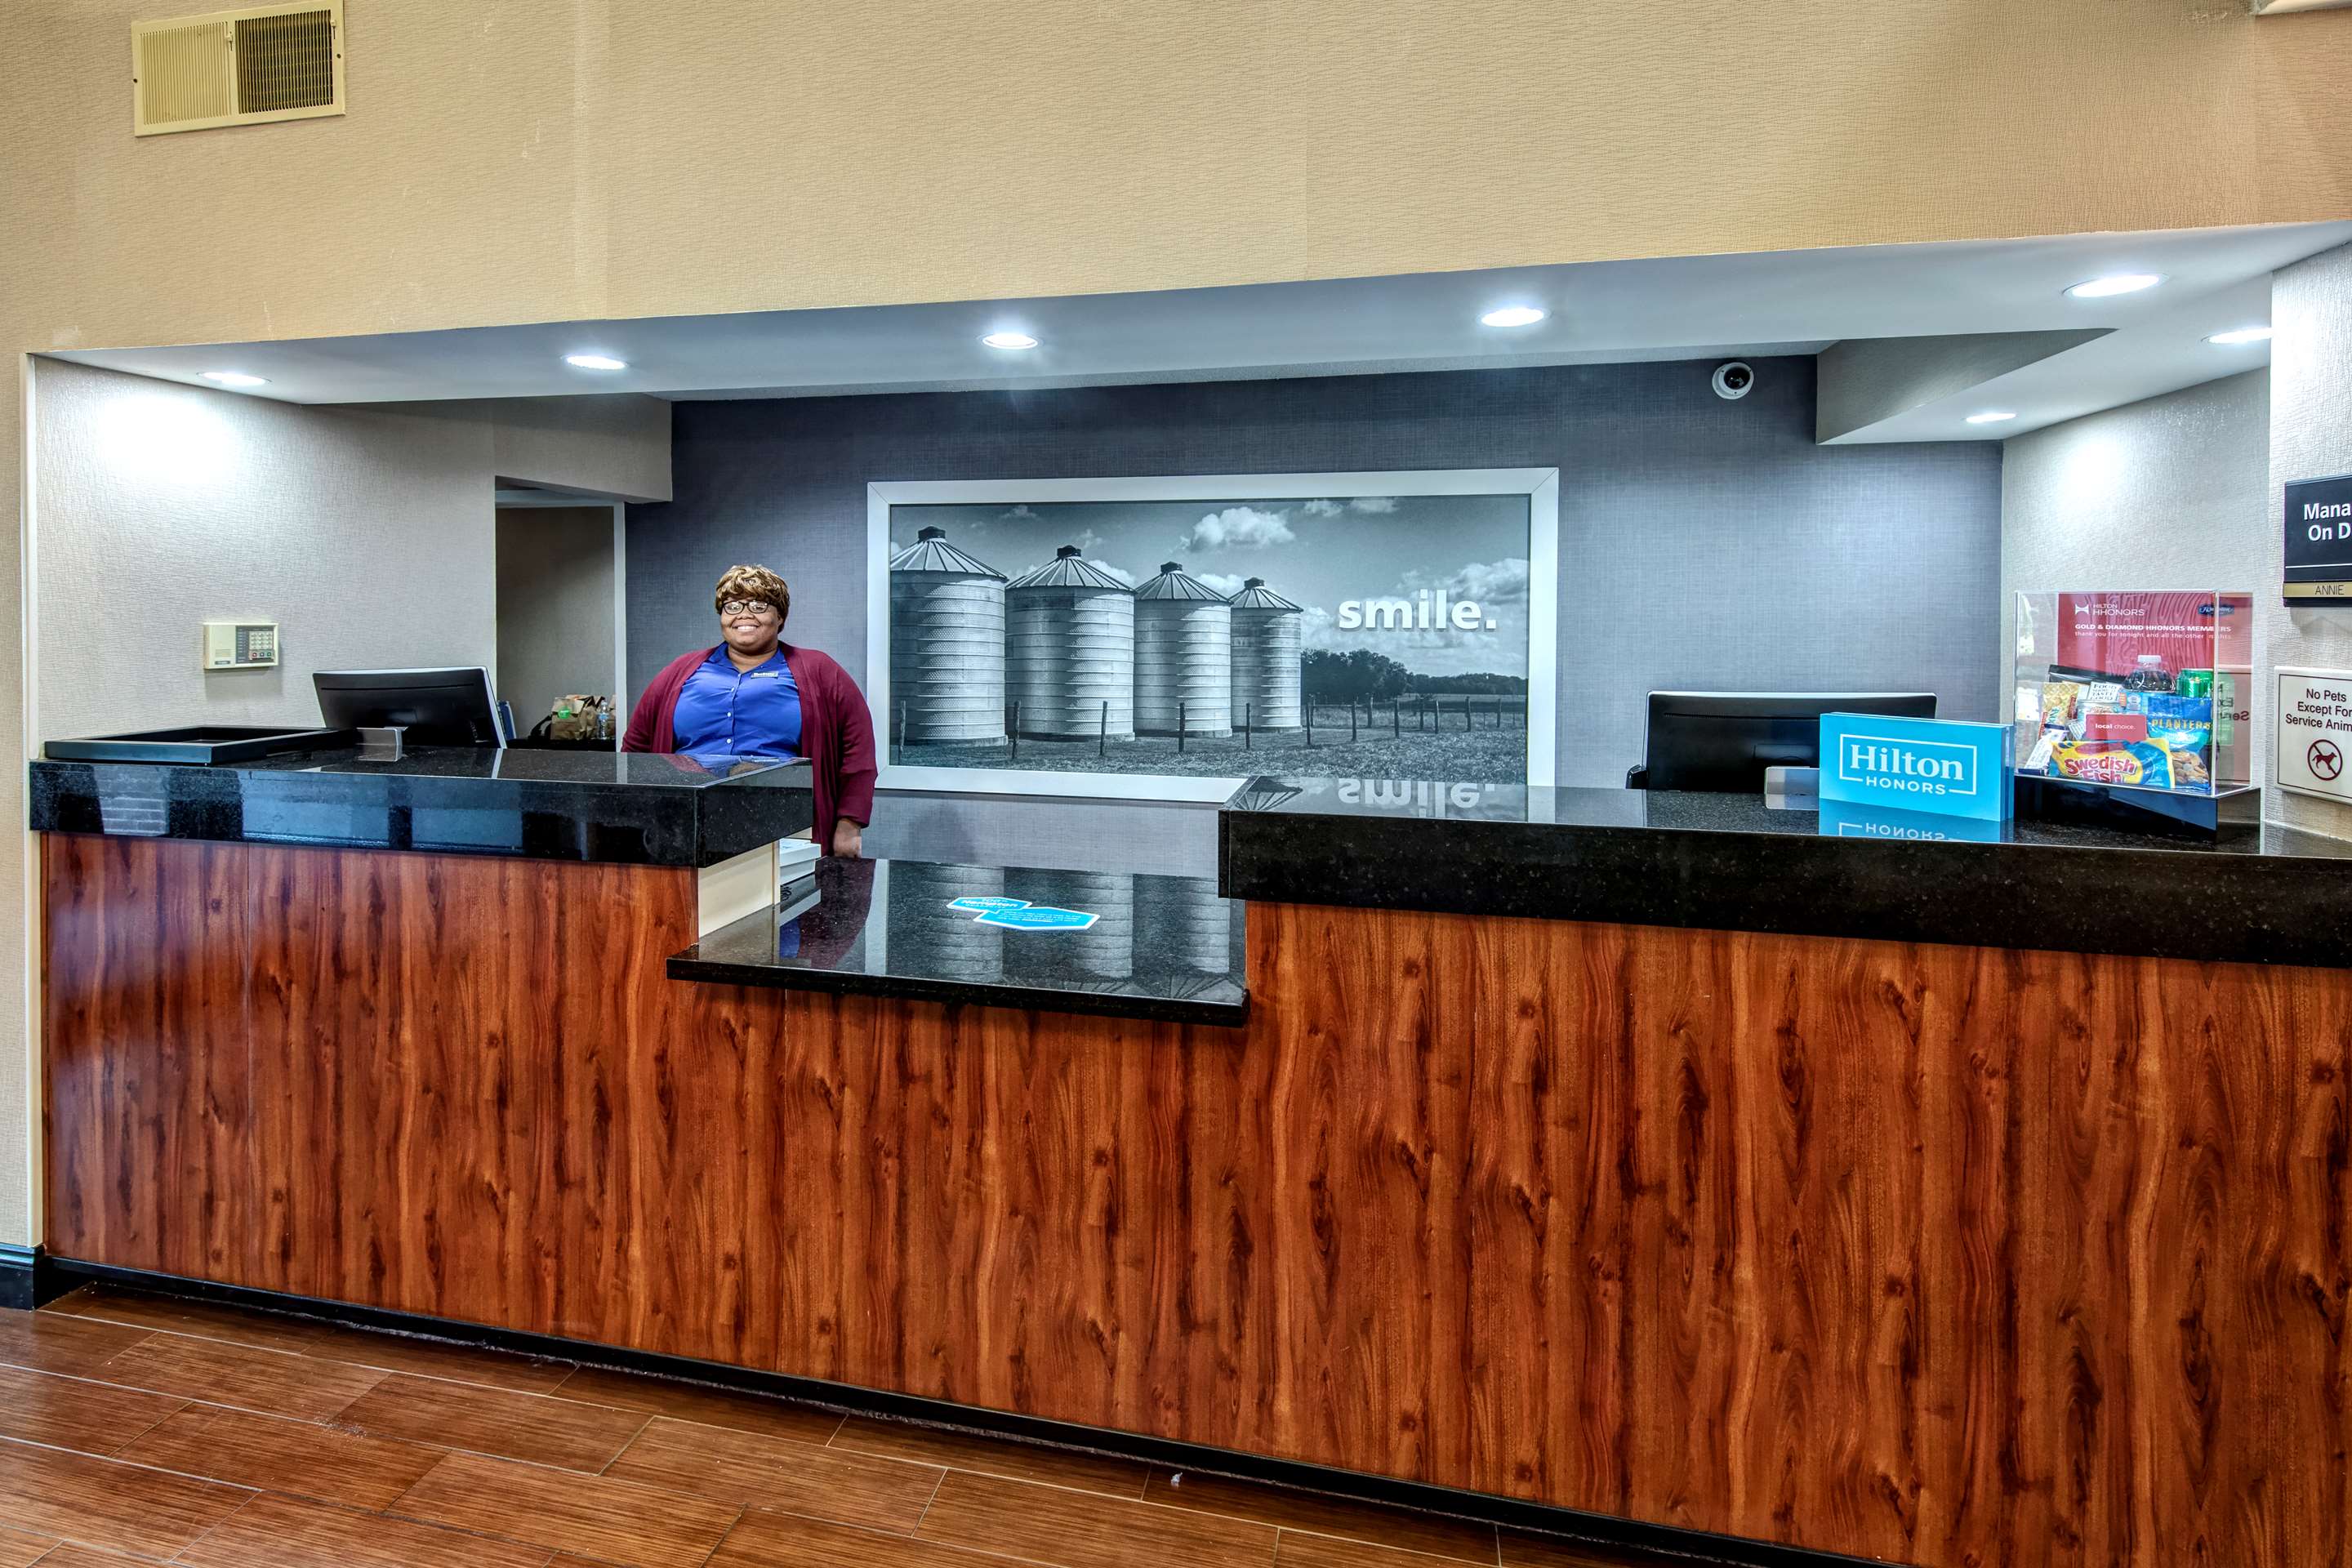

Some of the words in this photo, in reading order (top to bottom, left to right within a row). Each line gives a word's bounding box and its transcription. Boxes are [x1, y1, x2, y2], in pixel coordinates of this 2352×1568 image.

[2304, 502, 2351, 520] Mana
[2308, 524, 2332, 541] On
[2314, 584, 2345, 595] ANNIE
[1339, 589, 1496, 630] smile.
[2093, 608, 2145, 617] HHONORS
[2119, 631, 2145, 639] tonight
[2306, 688, 2320, 700] No
[2323, 690, 2346, 702] Pets
[2297, 701, 2332, 716] Except
[2335, 706, 2352, 717] For
[2151, 718, 2212, 730] PLANTERS
[2285, 713, 2323, 728] Service
[1850, 744, 1964, 781] Hilton
[2065, 756, 2137, 776] Swedish
[1866, 776, 1946, 795] HONORS
